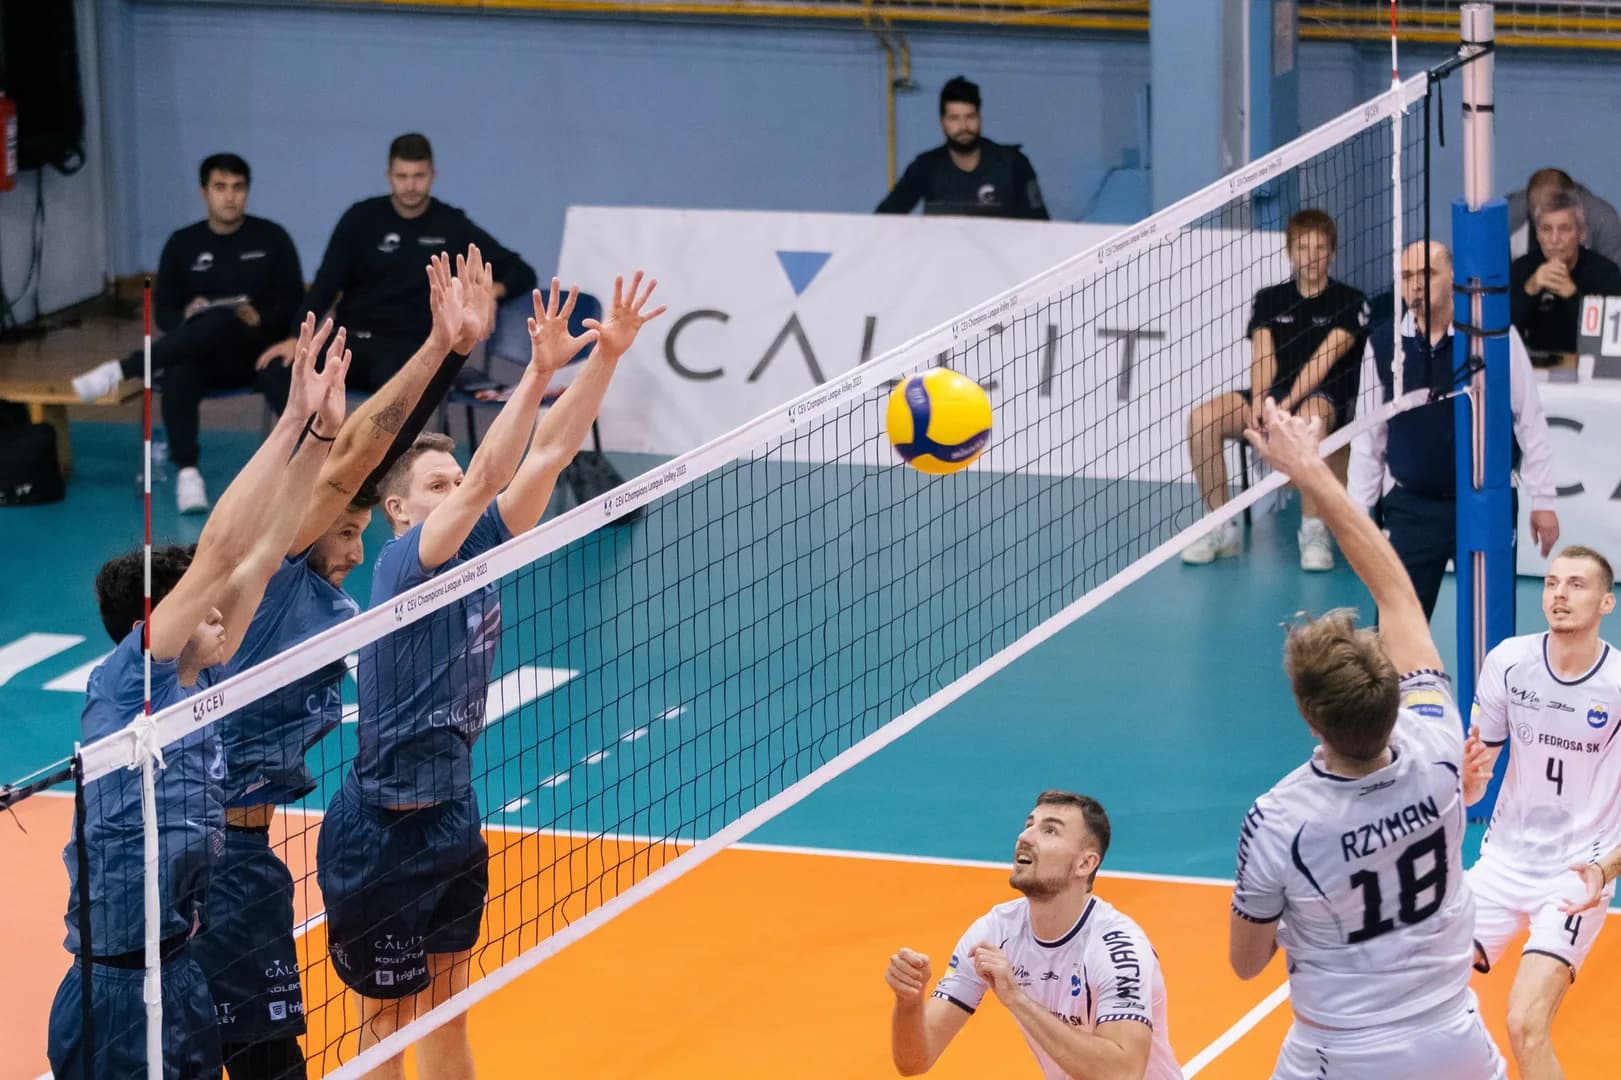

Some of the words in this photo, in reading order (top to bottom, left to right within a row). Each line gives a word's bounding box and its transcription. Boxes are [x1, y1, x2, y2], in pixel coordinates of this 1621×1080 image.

[1585, 305, 1599, 333] 0
[664, 308, 1167, 402] CALIT
[615, 495, 625, 508] CEV
[625, 485, 648, 503] Champions
[648, 478, 664, 492] League
[663, 471, 677, 484] Volley
[676, 463, 687, 478] 2023
[407, 599, 417, 612] CEV
[417, 586, 444, 607] Champions
[444, 578, 462, 593] League
[461, 570, 477, 585] Volley
[476, 562, 488, 578] 2023
[206, 691, 225, 712] CEV
[1538, 733, 1583, 752] FEDROSA
[1586, 743, 1600, 753] SK
[1546, 756, 1564, 796] 4
[1340, 795, 1440, 862] RZYMAN
[1347, 824, 1448, 945] 18
[1564, 914, 1582, 946] 4
[1102, 930, 1141, 1001] MYJAVA
